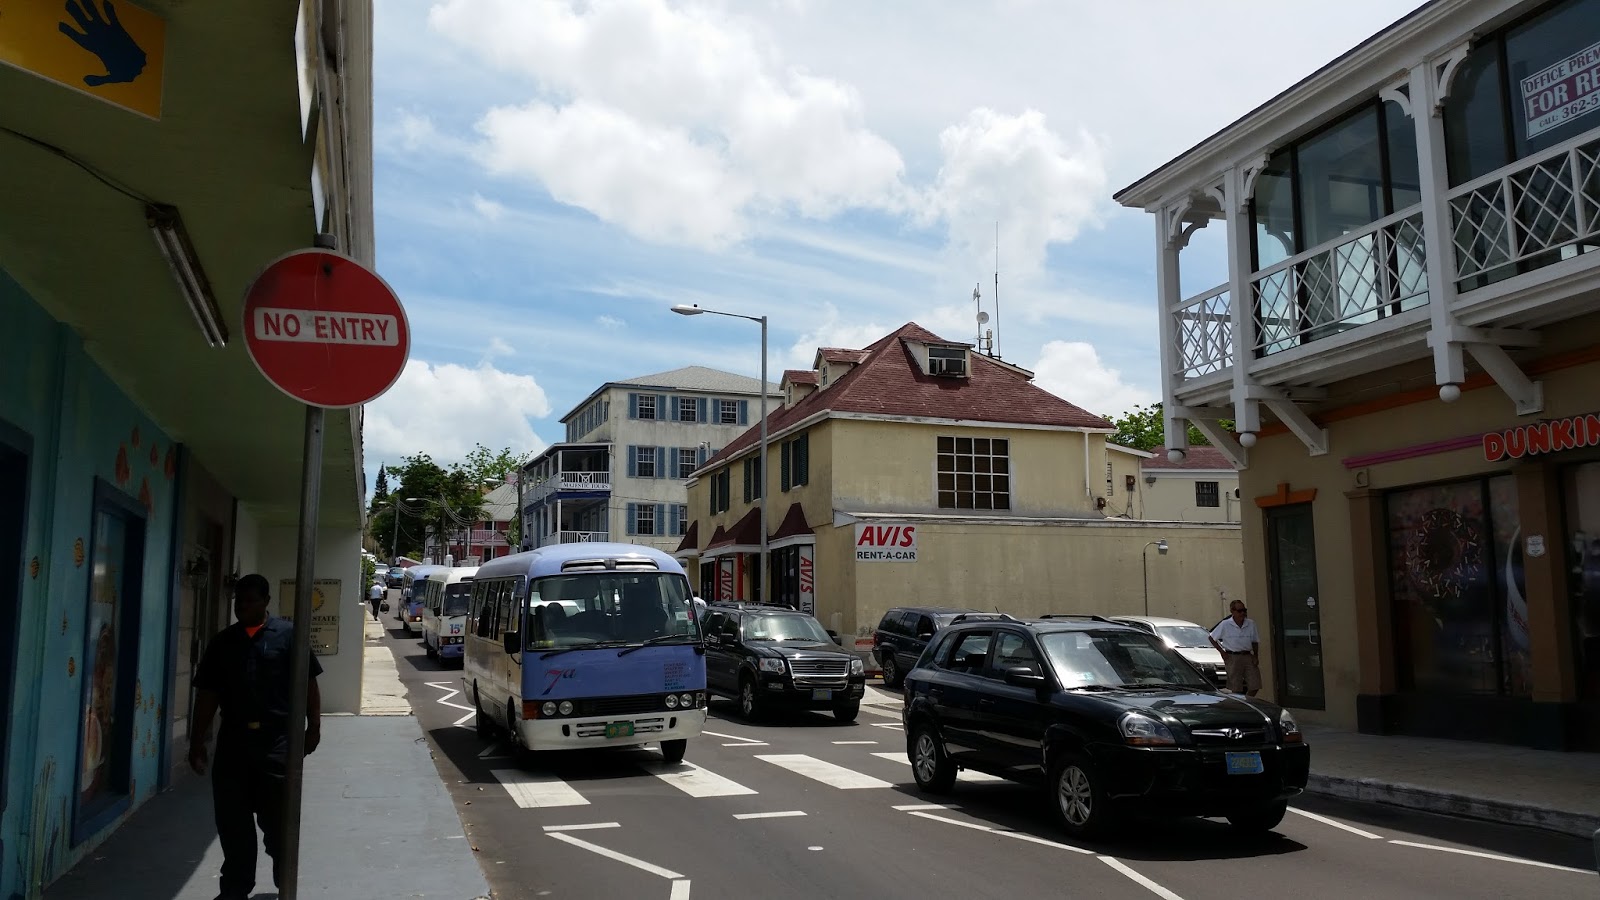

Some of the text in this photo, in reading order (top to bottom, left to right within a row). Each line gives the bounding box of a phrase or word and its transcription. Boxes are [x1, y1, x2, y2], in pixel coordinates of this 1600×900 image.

[1525, 64, 1566, 93] OFFICE
[1527, 83, 1569, 119] FOR
[1539, 114, 1559, 128] CALL:
[263, 312, 389, 341] NO ENTRY
[857, 526, 916, 547] AVIS
[857, 551, 916, 560] RENT-A-CAR
[721, 569, 733, 601] AVIS
[800, 556, 813, 594] AVIS
